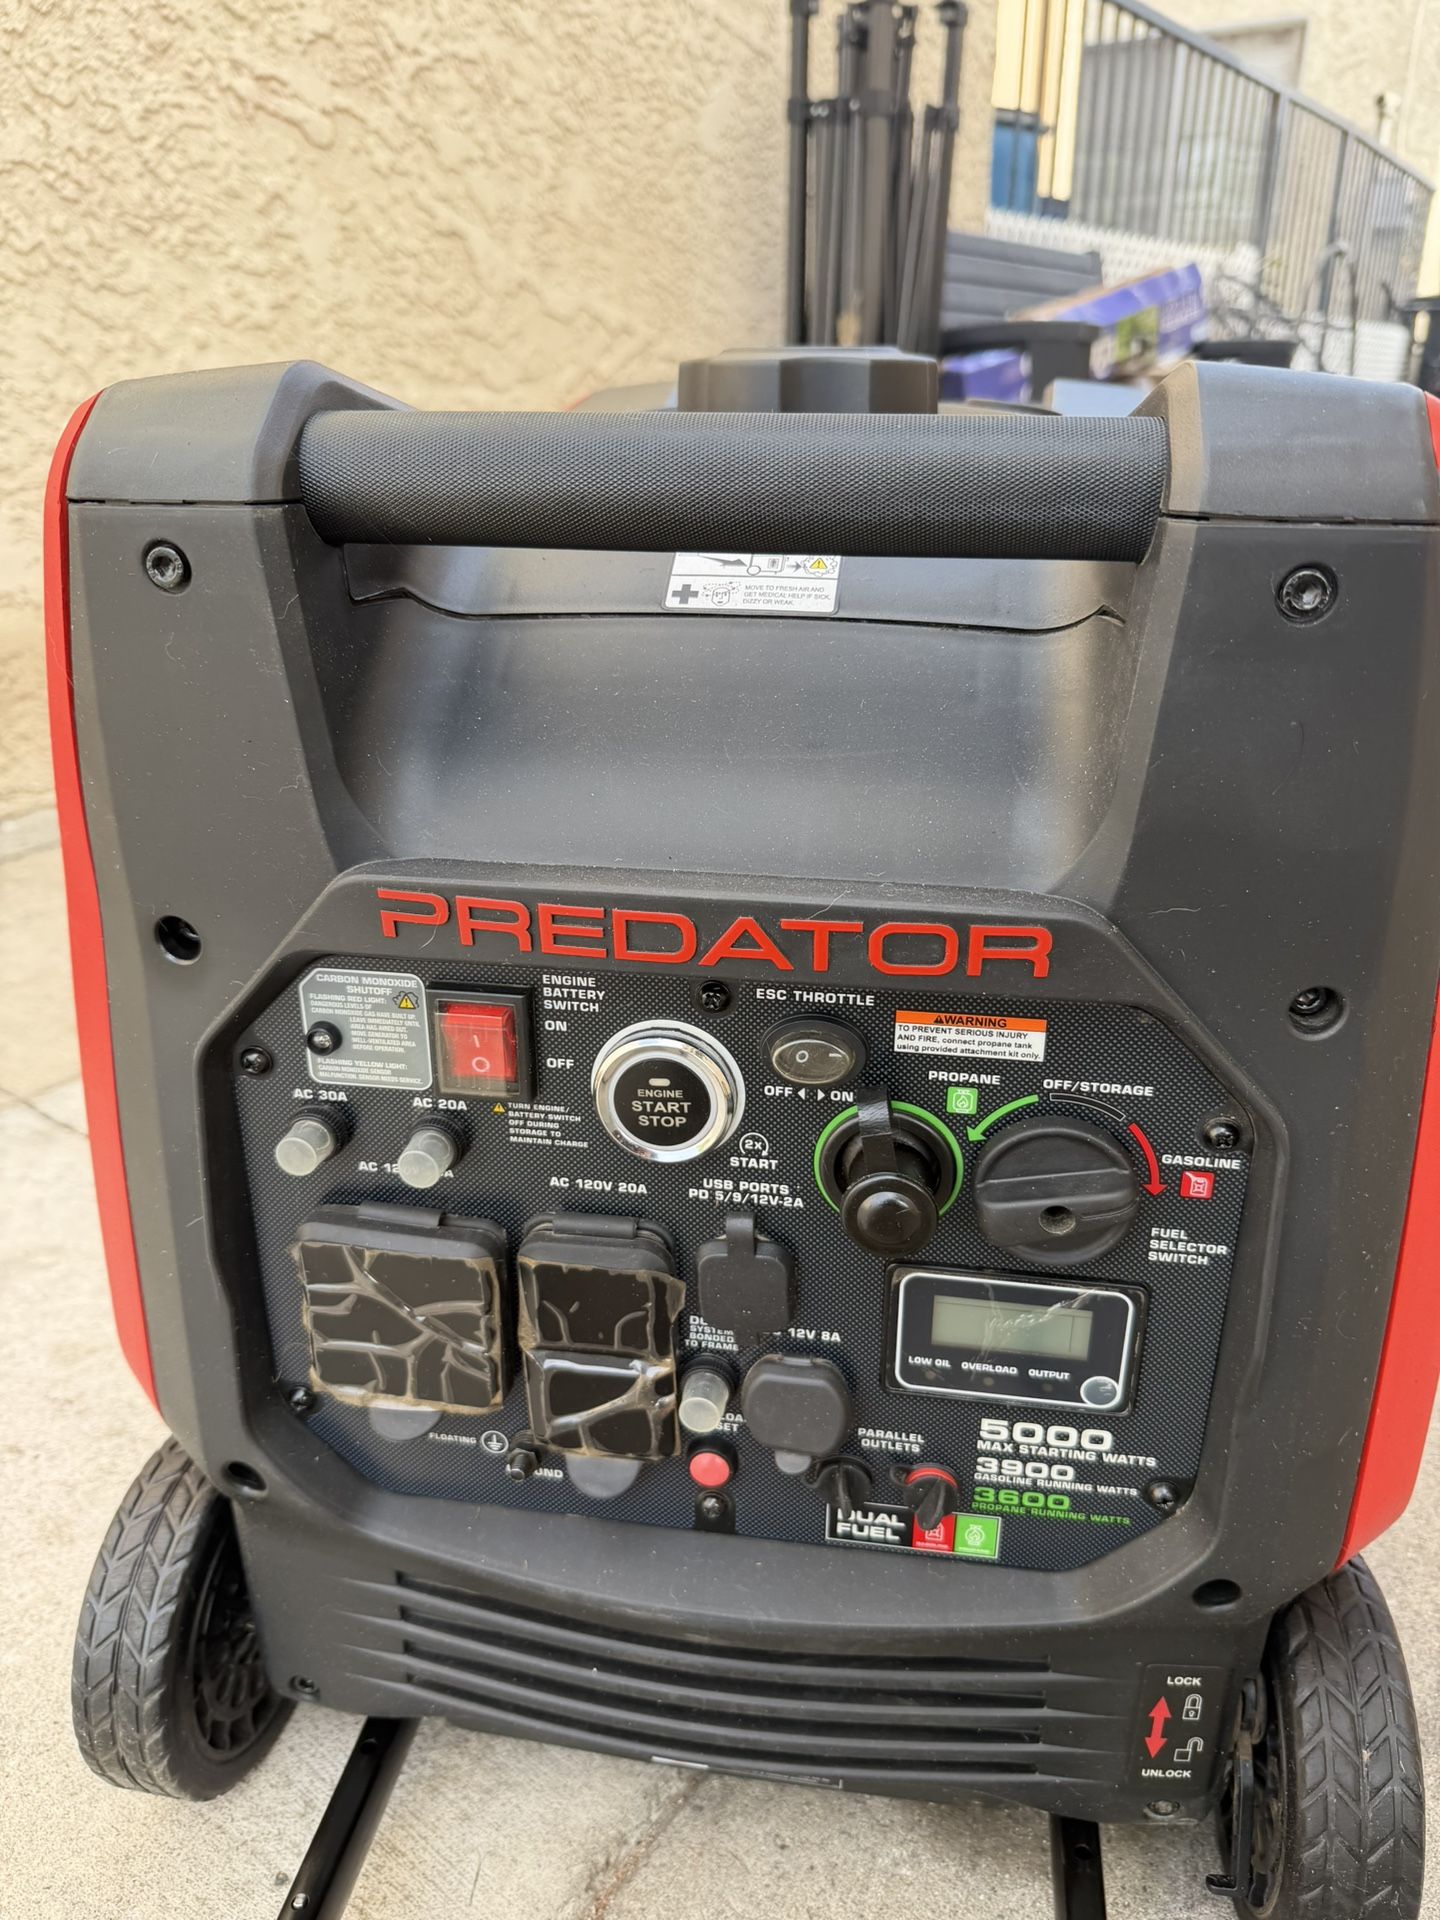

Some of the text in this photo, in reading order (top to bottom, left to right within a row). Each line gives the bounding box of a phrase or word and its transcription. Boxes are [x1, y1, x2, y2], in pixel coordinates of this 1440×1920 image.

[377, 889, 1053, 978] PREDATOR
[316, 974, 418, 988] CARBON MONOXIDE
[542, 974, 596, 987] ENGINE
[310, 993, 345, 1001] FLASHING
[346, 985, 392, 996] SHUTOFF
[543, 987, 605, 1000] BATTERY
[756, 988, 874, 1006] ESC THROTTLE
[544, 1000, 599, 1012] SWITCH
[544, 1020, 567, 1031] ON
[943, 1015, 1007, 1028] WARNING
[898, 1024, 1028, 1040] TO PREVENT SERIOUS INJURY
[897, 1034, 1032, 1049] AND FIRE, connect propane tank
[896, 1044, 1040, 1060] using provided attachment kit only.
[318, 1058, 352, 1066] FLASHING
[355, 1060, 384, 1068] YELLOW
[546, 1058, 574, 1069] OFF
[928, 1071, 1001, 1085] PROPANE
[294, 1088, 348, 1101] AC 30A
[638, 1089, 683, 1099] ENGINE
[764, 1085, 854, 1102] OFF ON
[1043, 1079, 1154, 1097] OFF/STORAGE
[413, 1097, 467, 1111] AC 20A
[508, 1102, 569, 1113] TURN ENGINE/
[632, 1101, 691, 1114] START
[508, 1110, 581, 1122] BATTERY SWITCH
[638, 1116, 687, 1127] STOP
[527, 1120, 559, 1129] DURING
[509, 1128, 548, 1136] STORAGE
[510, 1136, 588, 1148] MAINTAIN CHARGE
[744, 1139, 762, 1150] 2x
[359, 1161, 378, 1171] AC
[730, 1156, 778, 1170] START
[1162, 1154, 1241, 1170] GASOLINE
[550, 1177, 647, 1194] AC 120V 20A
[703, 1178, 789, 1195] USB PORTS
[689, 1188, 804, 1208] PD 5/9/12V-2A
[1151, 1227, 1188, 1239] FUEL
[1150, 1239, 1227, 1255] SELECTOR
[1148, 1252, 1208, 1265] SWITCH
[690, 1333, 734, 1342] BONDED
[788, 1328, 816, 1339] 12V
[822, 1331, 841, 1342] 8A
[685, 1339, 739, 1351] TO FRAME
[908, 1355, 951, 1367] LOW OIL
[961, 1362, 1018, 1375] OVERLOAD
[1028, 1368, 1071, 1381] OUTPUT
[429, 1432, 476, 1444] FLOATING
[858, 1427, 924, 1443] PARALLEL
[979, 1418, 1113, 1450] 5000
[861, 1438, 920, 1452] OUTLETS
[977, 1440, 1156, 1467] MAX STARTING WATTS
[976, 1456, 1075, 1481] 3900
[974, 1473, 1138, 1496] GASOLINE RUNNING WATTS
[973, 1487, 1070, 1510] 3600
[972, 1502, 1131, 1525] PROPANE RUNNING WATTS
[836, 1522, 900, 1540] FUEL
[1167, 1676, 1202, 1686] LOCK
[1141, 1768, 1191, 1778] UNLOCK
